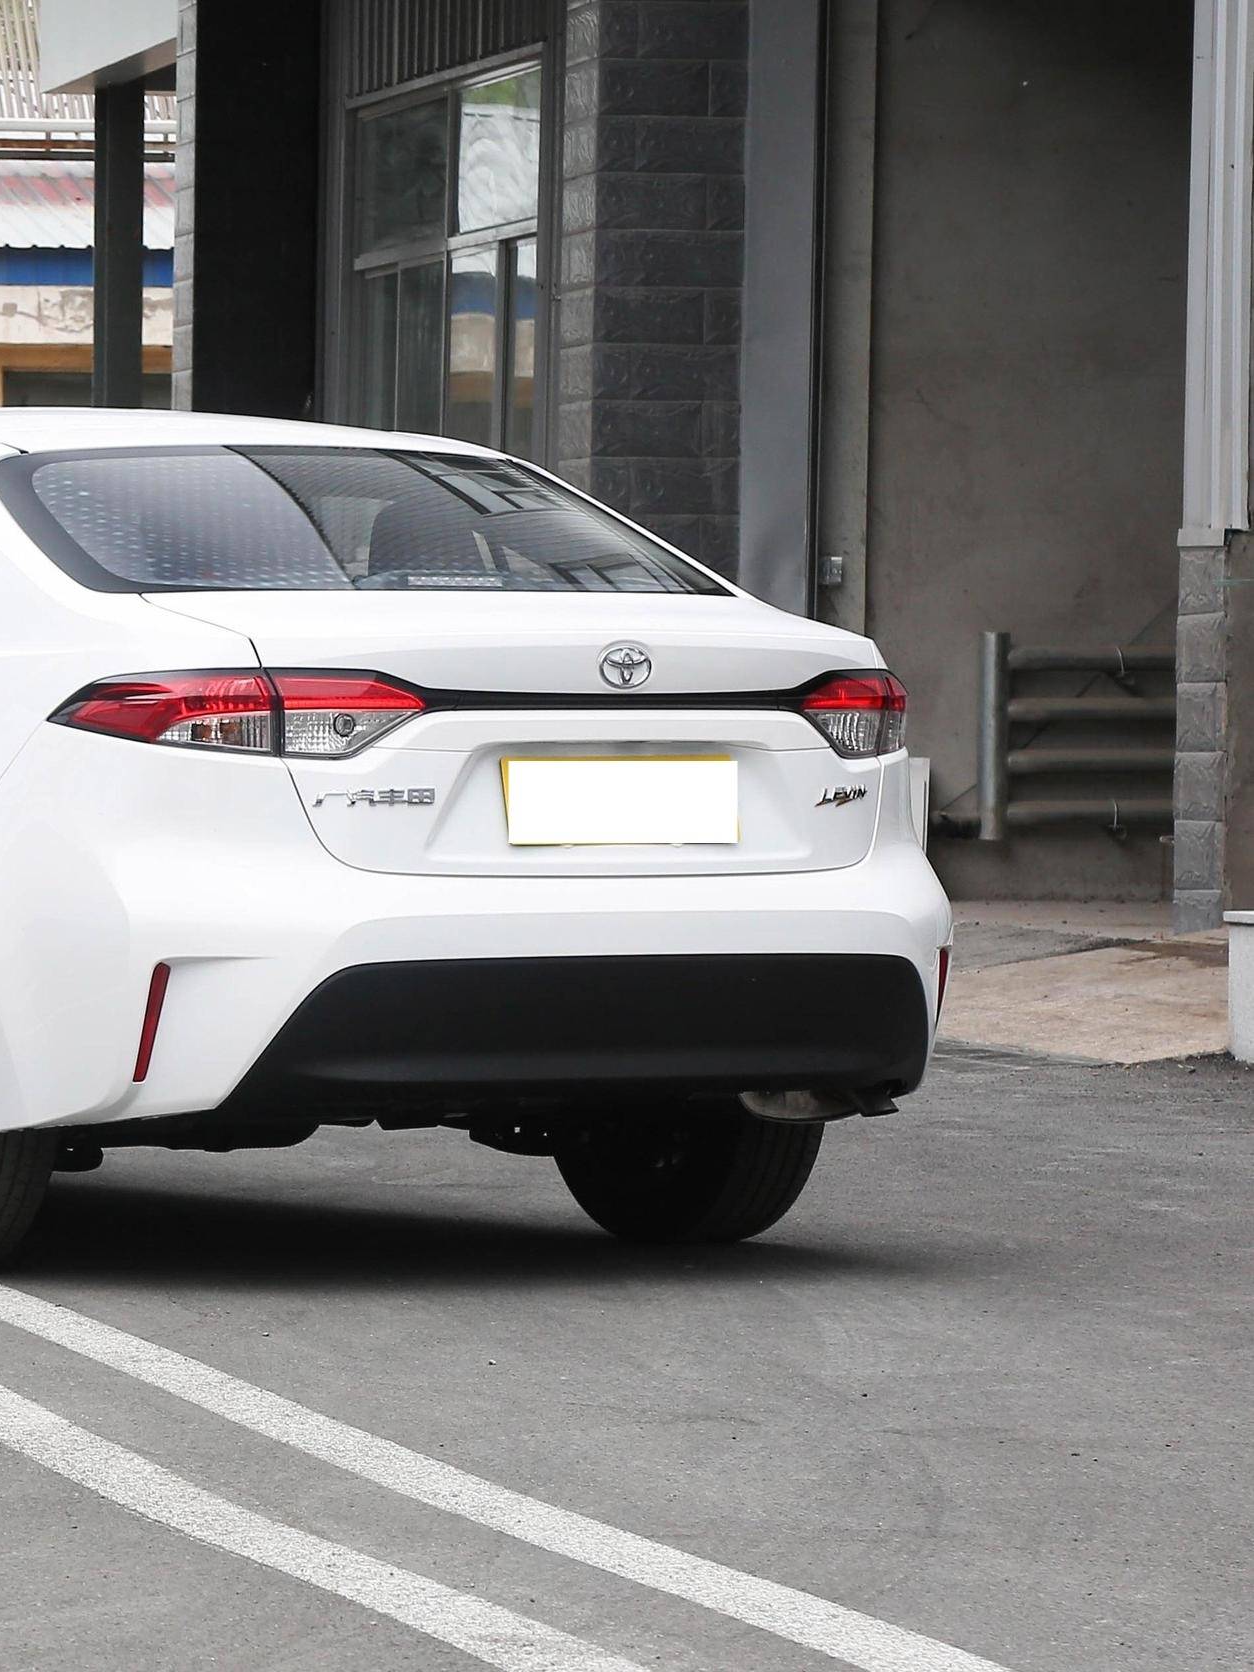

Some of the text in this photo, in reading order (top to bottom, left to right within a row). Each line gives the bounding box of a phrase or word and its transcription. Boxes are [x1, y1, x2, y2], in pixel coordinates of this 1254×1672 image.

[313, 788, 435, 807] 广汽丰田
[815, 785, 867, 807] LEVIN
